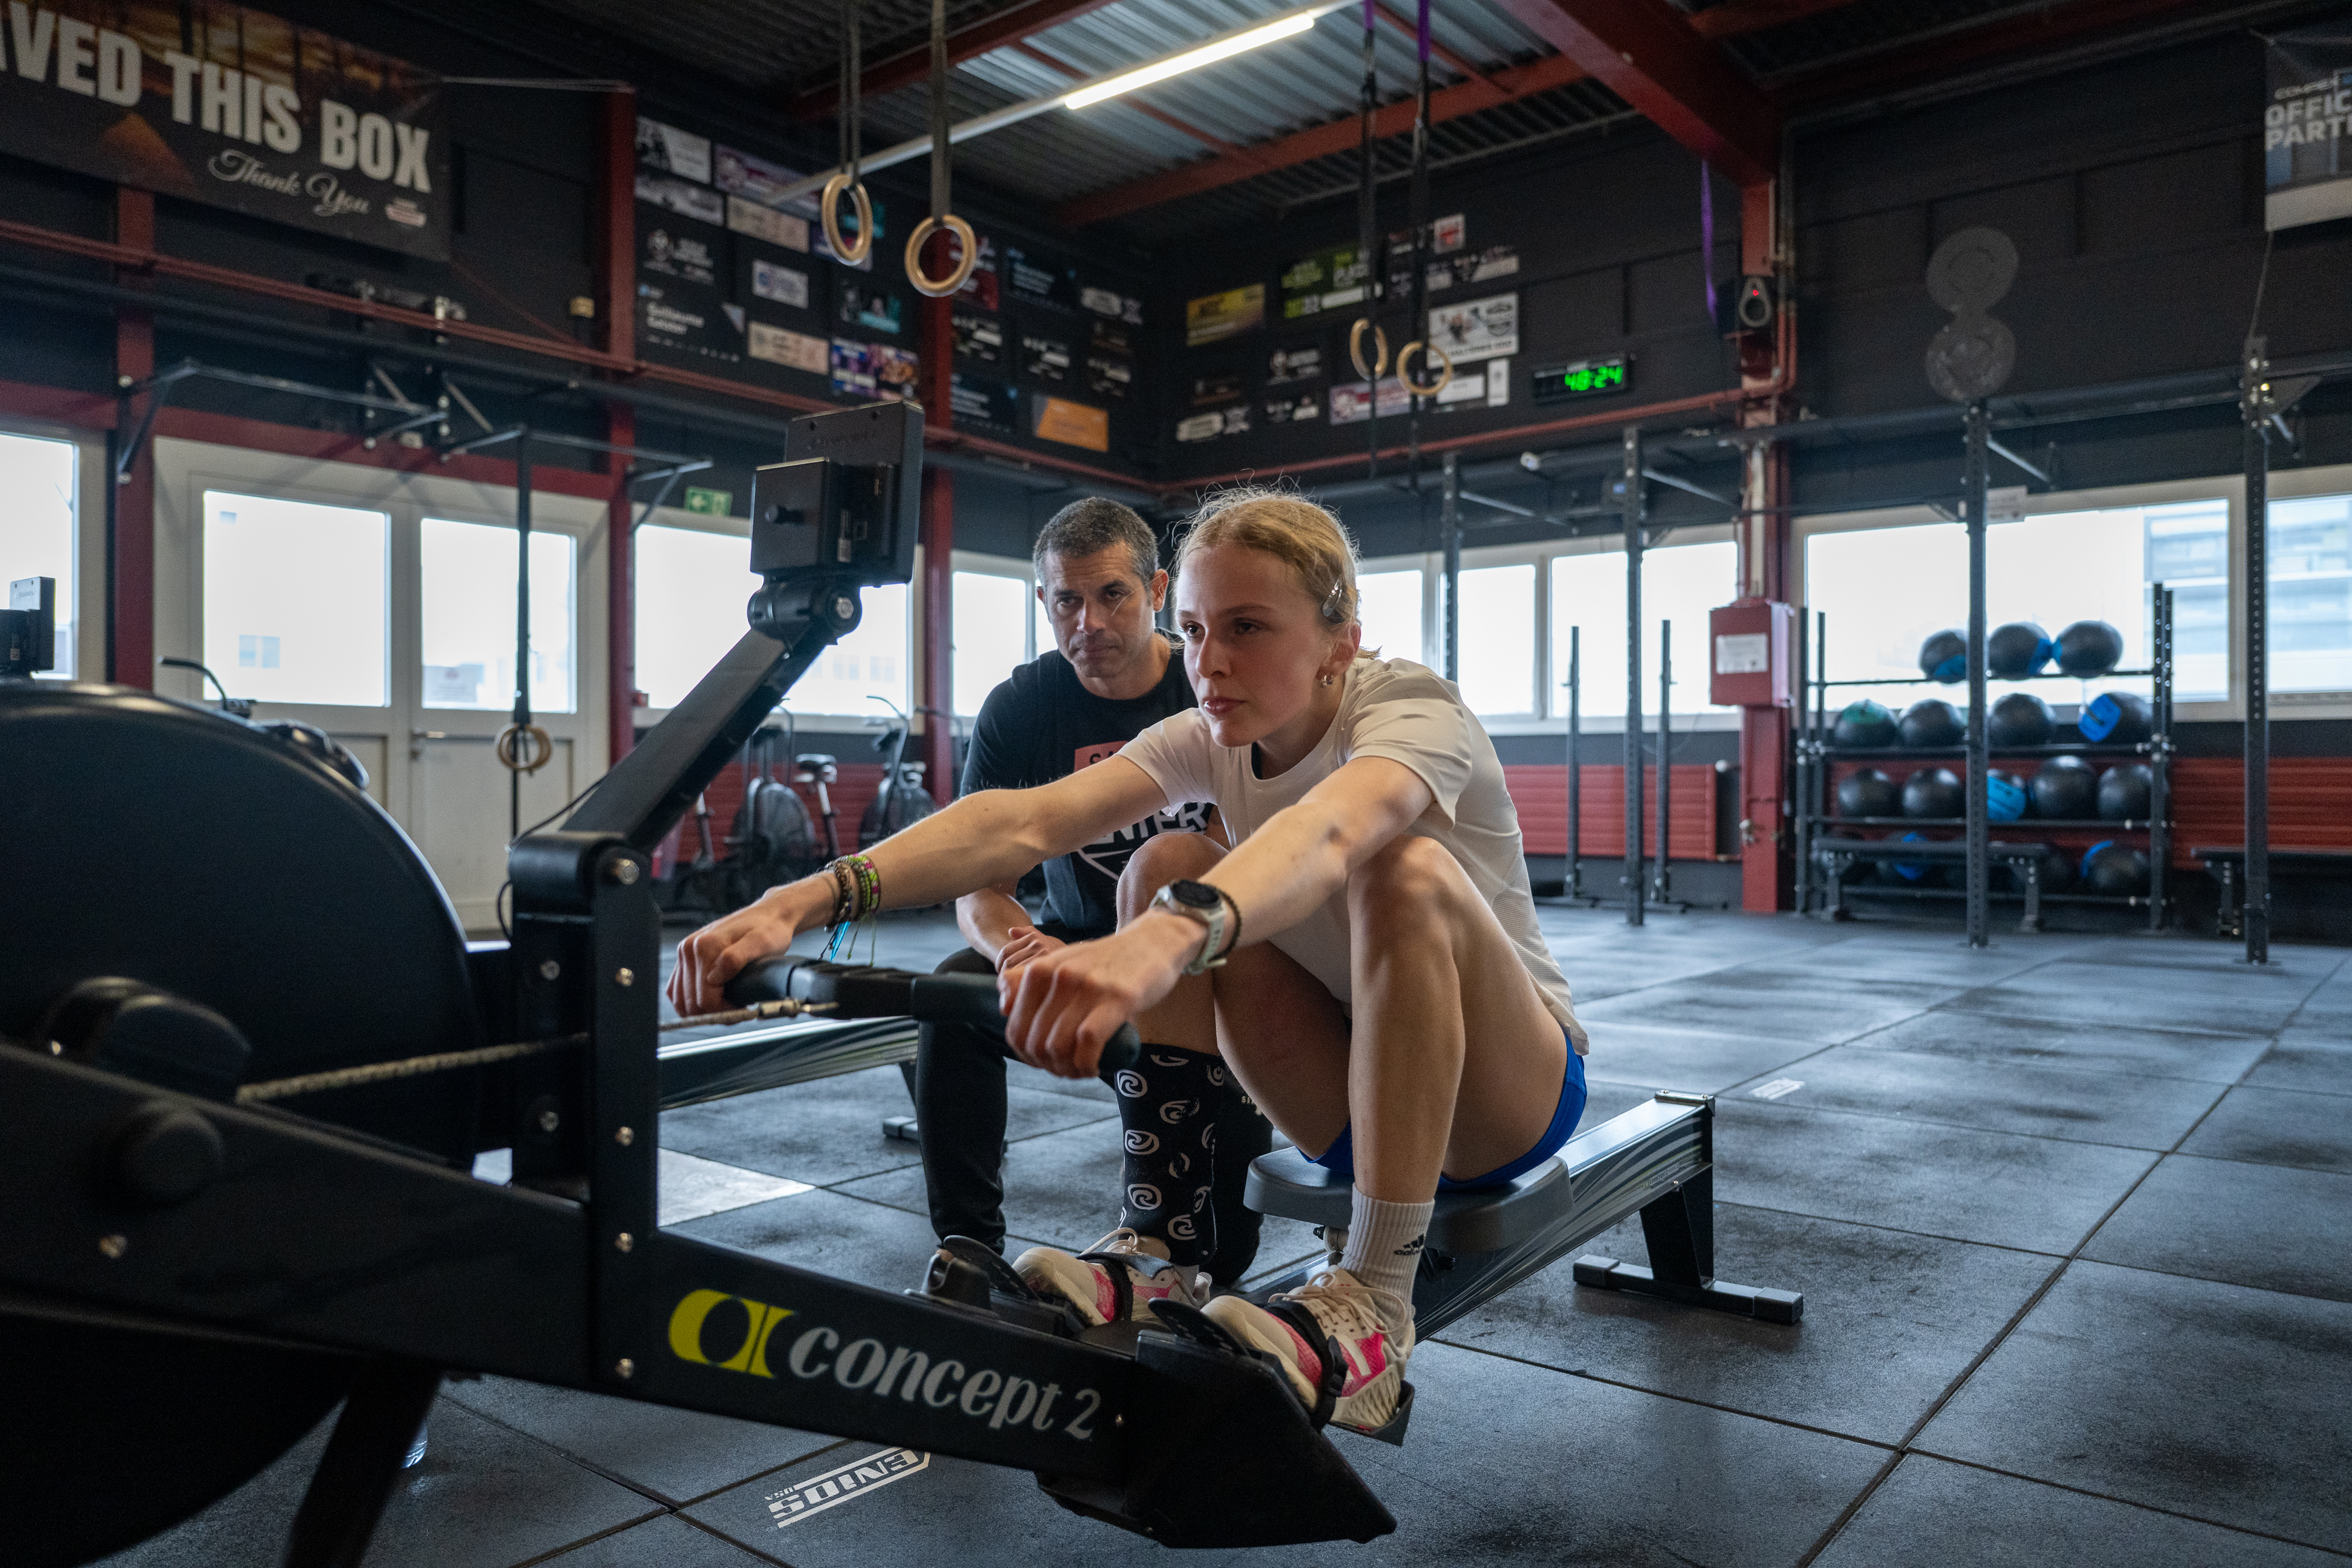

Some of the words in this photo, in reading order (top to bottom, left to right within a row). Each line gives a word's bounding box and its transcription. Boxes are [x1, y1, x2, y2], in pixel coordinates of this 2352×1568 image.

[165, 51, 302, 154] THIS
[320, 98, 432, 193] BOX
[208, 149, 300, 196] Thank
[305, 173, 369, 217] You
[788, 1326, 1062, 1430] concept
[1064, 1388, 1101, 1440] 2
[764, 1486, 794, 1501] USA
